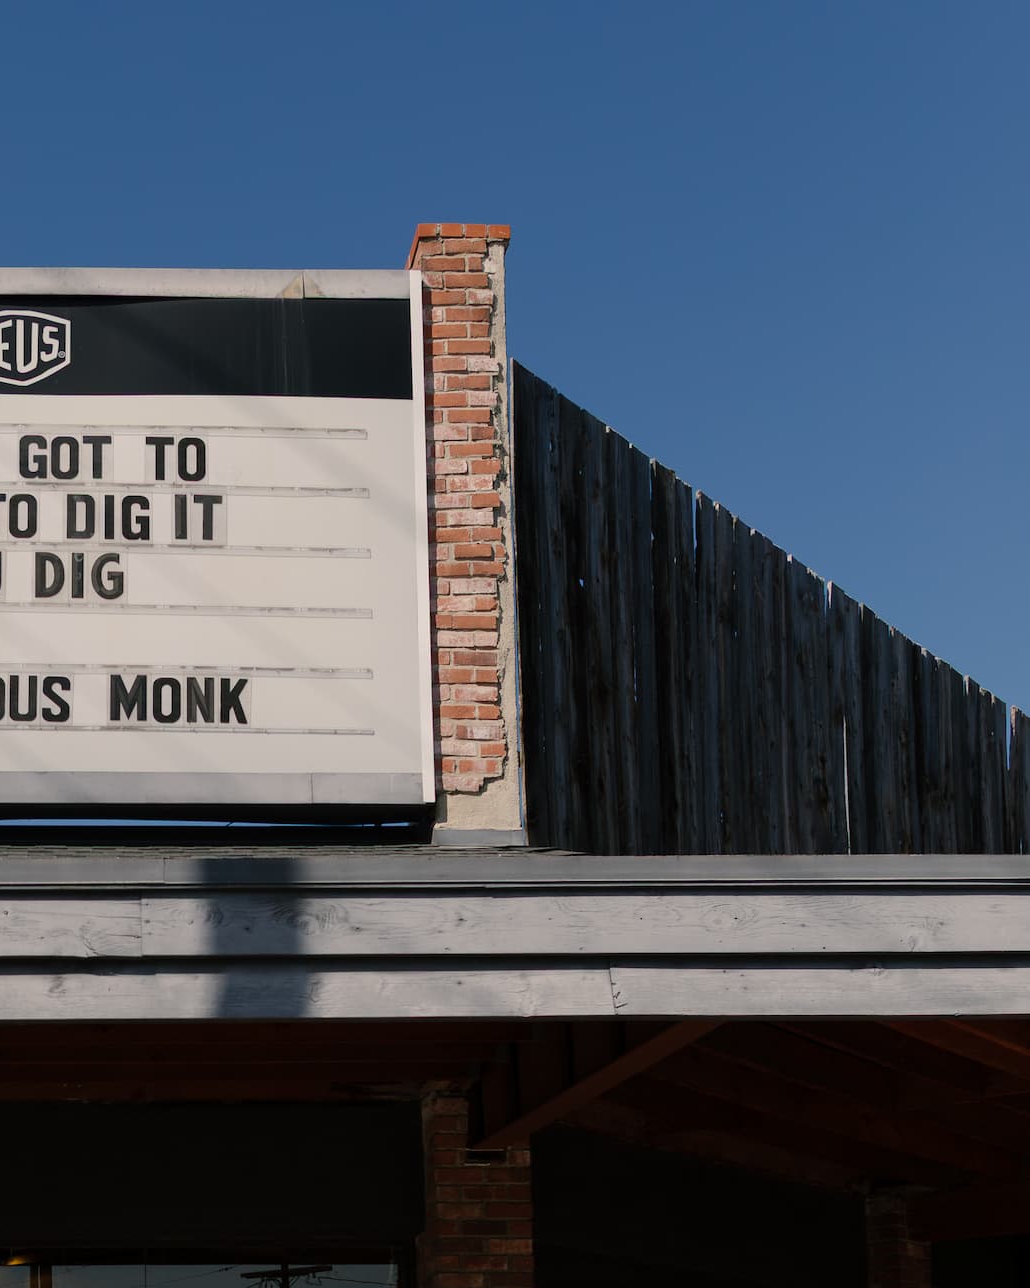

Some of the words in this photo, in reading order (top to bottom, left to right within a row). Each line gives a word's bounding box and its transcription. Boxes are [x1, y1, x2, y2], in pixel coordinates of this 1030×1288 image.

[19, 435, 111, 479] GOT
[146, 437, 206, 481] TO
[67, 494, 149, 540] DIG
[175, 495, 222, 540] IT
[35, 552, 123, 599] DIG
[110, 675, 248, 724] MONK
